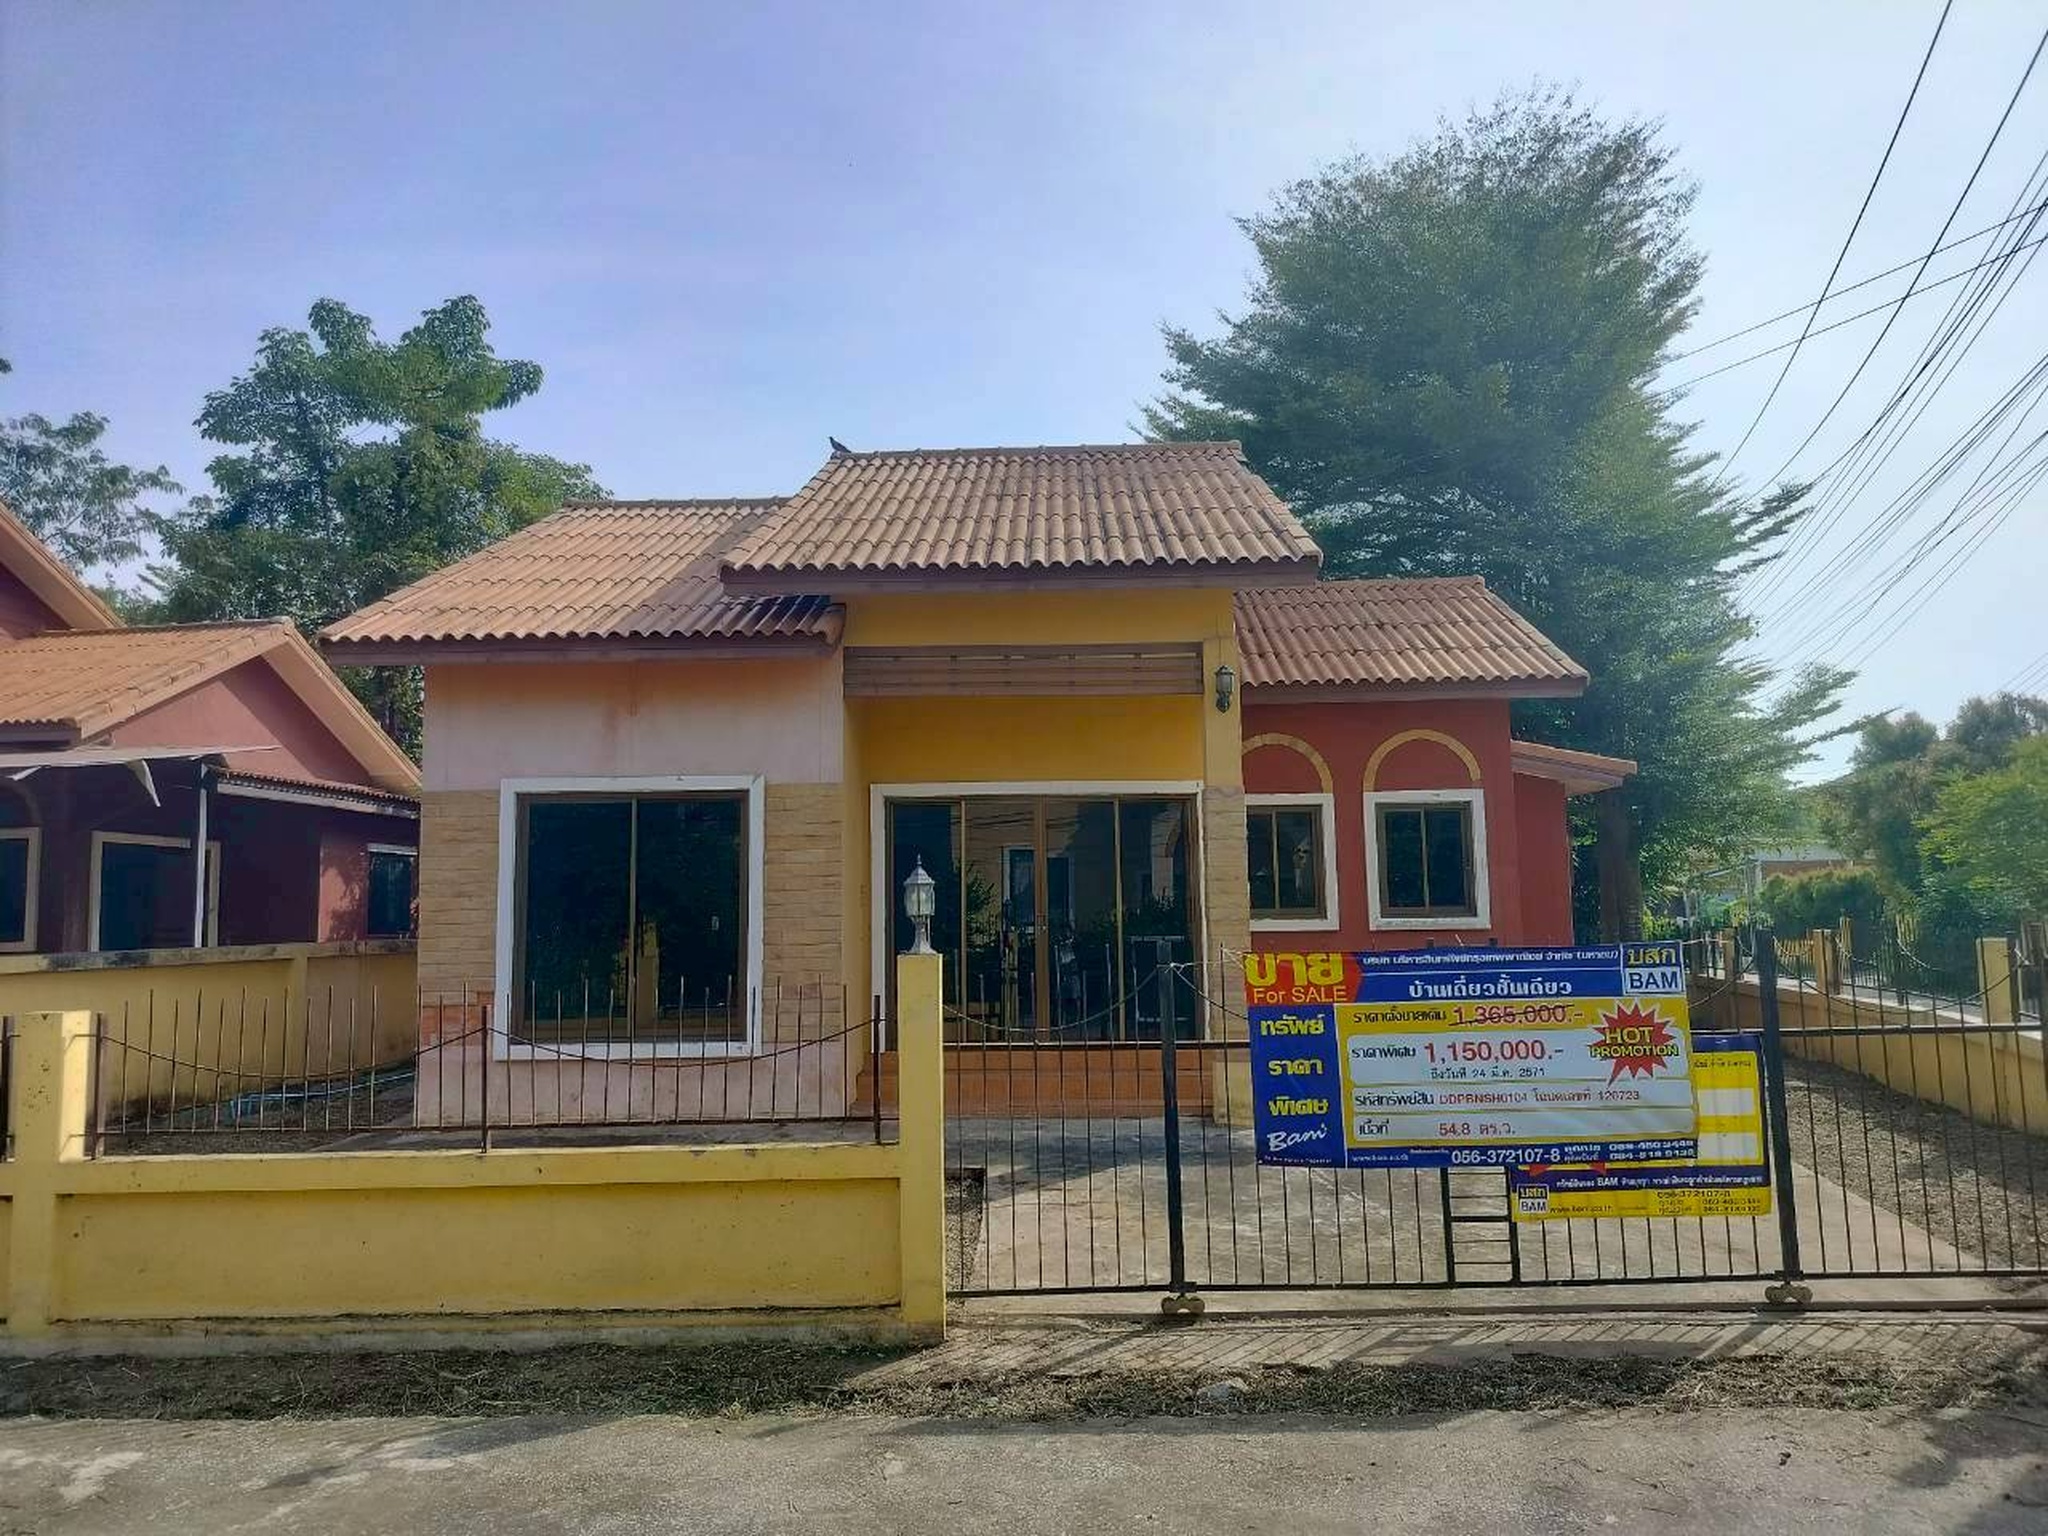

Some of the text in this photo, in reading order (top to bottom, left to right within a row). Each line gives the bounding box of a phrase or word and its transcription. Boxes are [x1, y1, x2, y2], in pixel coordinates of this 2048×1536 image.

[1627, 947, 1677, 967] บสก
[1244, 952, 1344, 987] ขาย
[1408, 974, 1573, 998] บ้านเดี่ยวชั้นเดียว
[1629, 970, 1679, 990] BAM
[1254, 985, 1348, 1004] For SALE
[1260, 1013, 1326, 1036] ทรัพย์
[1604, 1027, 1654, 1044] HOT
[1351, 1043, 1416, 1059] ราคาพิเศษ
[1590, 1045, 1679, 1058] PROMOTION
[1268, 1059, 1323, 1076] ราคา
[1268, 1095, 1329, 1116] พิเศษ
[1355, 1091, 1435, 1107] รหัสทรัพย์สิน
[1358, 1117, 1390, 1136] เนื้อที่
[1451, 1148, 1560, 1168] 056-372107-8
[1597, 1177, 1619, 1187] BAM
[1520, 1200, 1547, 1213] BAM
